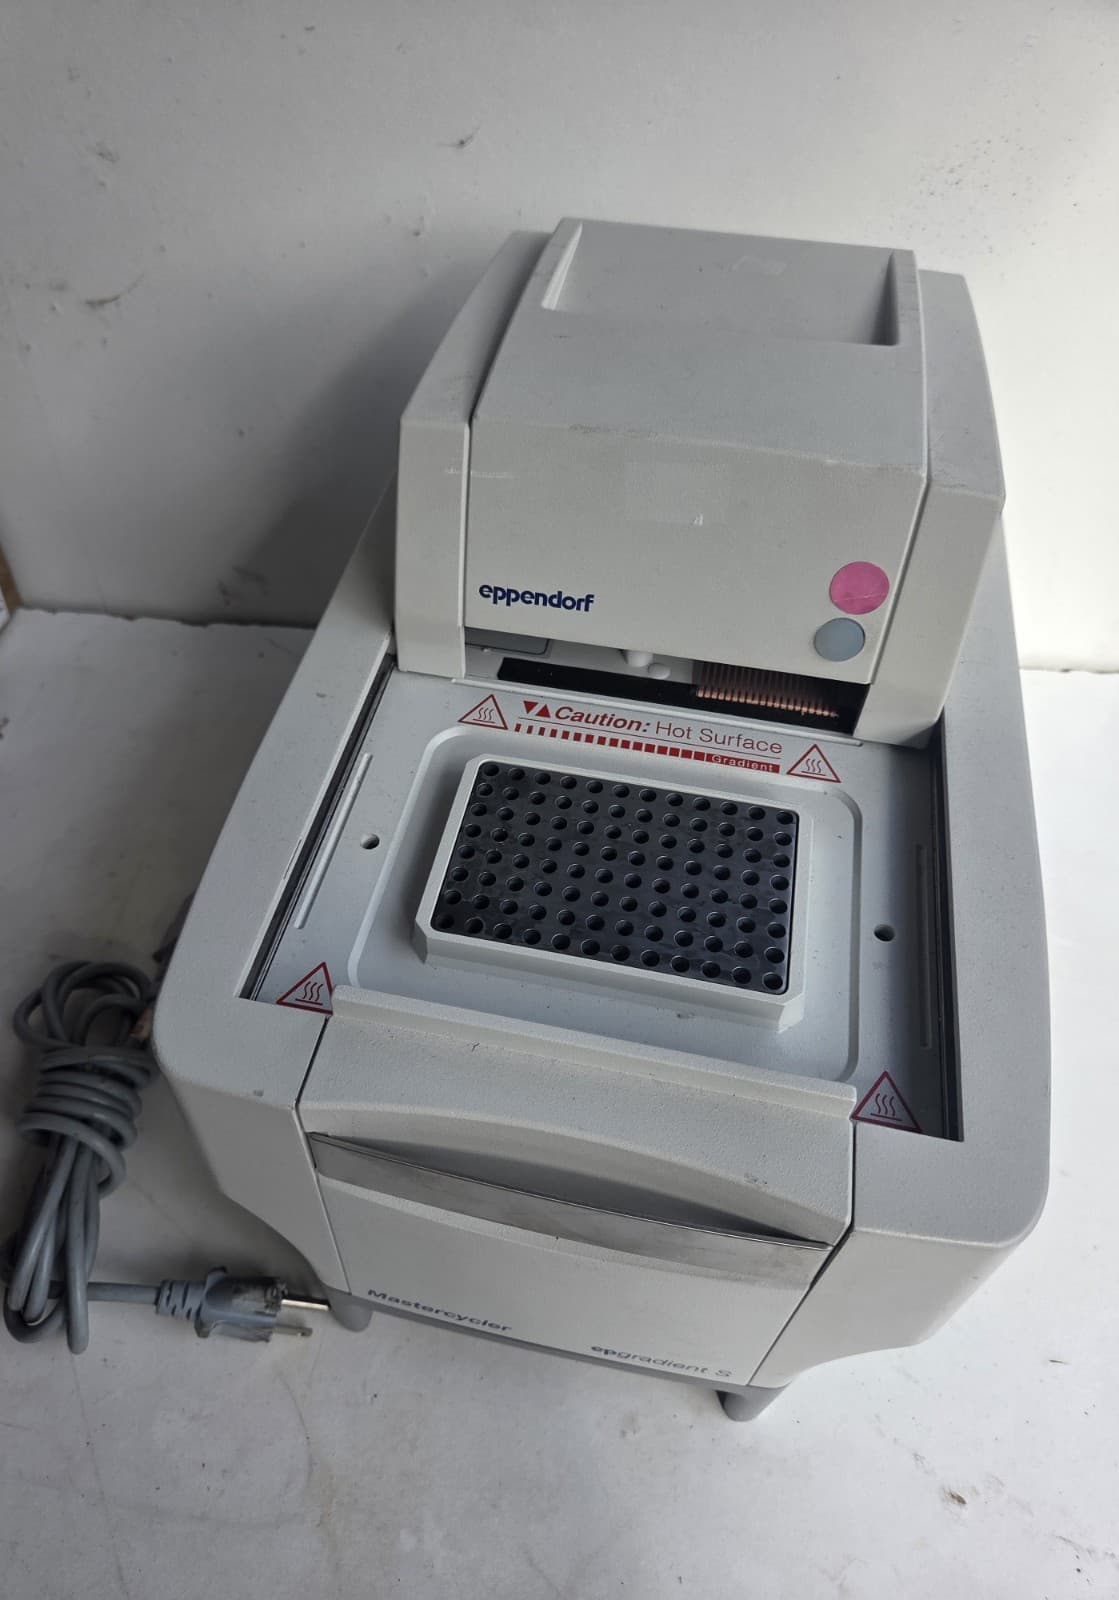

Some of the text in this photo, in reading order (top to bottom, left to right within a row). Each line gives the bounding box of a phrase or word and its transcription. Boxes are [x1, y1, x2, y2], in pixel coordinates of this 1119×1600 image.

[479, 584, 595, 612] eppendorf
[554, 705, 783, 754] Caution: Hot Surface
[711, 754, 775, 772] Gradient
[367, 1289, 512, 1332] Mastercycler
[590, 1345, 733, 1378] epgradient S
